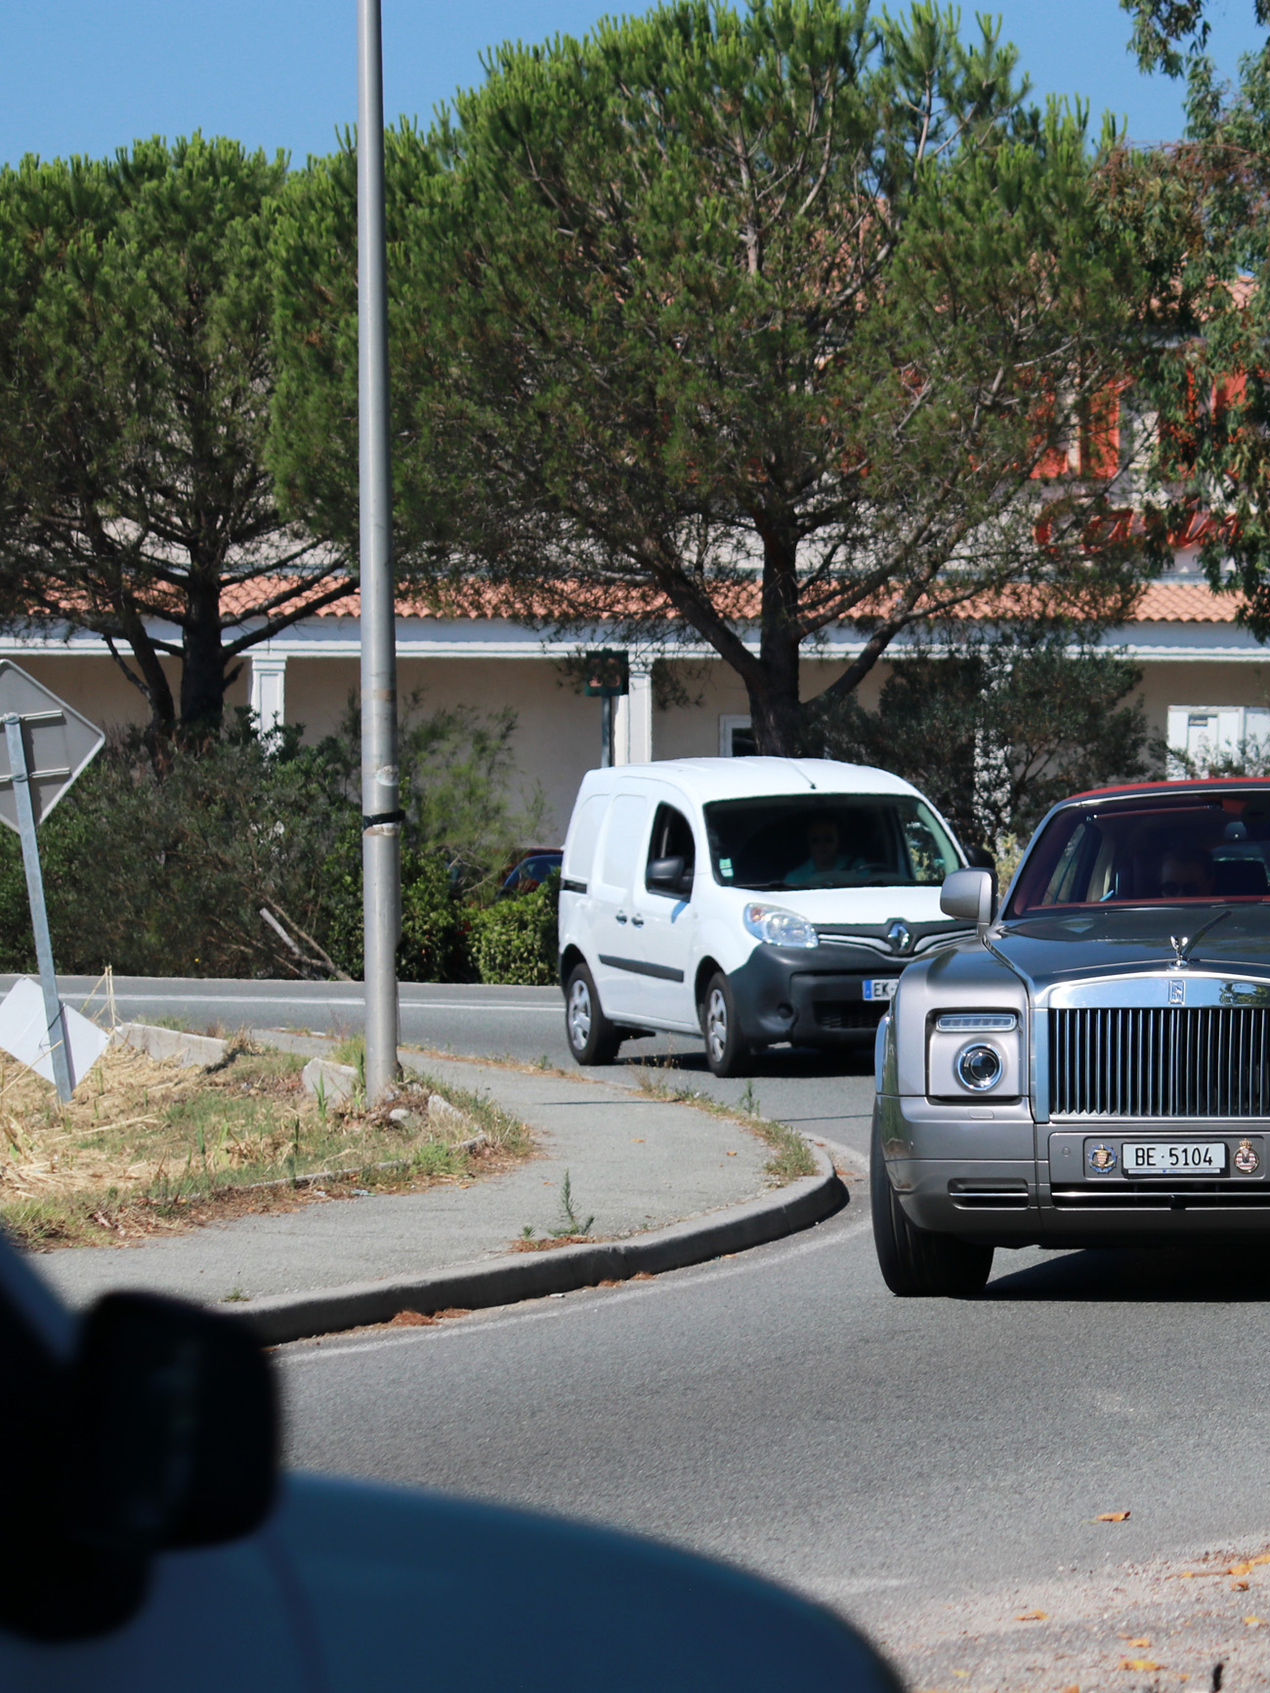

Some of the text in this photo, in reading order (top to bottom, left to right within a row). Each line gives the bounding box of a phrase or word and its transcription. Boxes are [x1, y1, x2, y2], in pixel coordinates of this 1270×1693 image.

[874, 982, 899, 997] EK-
[1135, 1147, 1213, 1166] BE 5104
